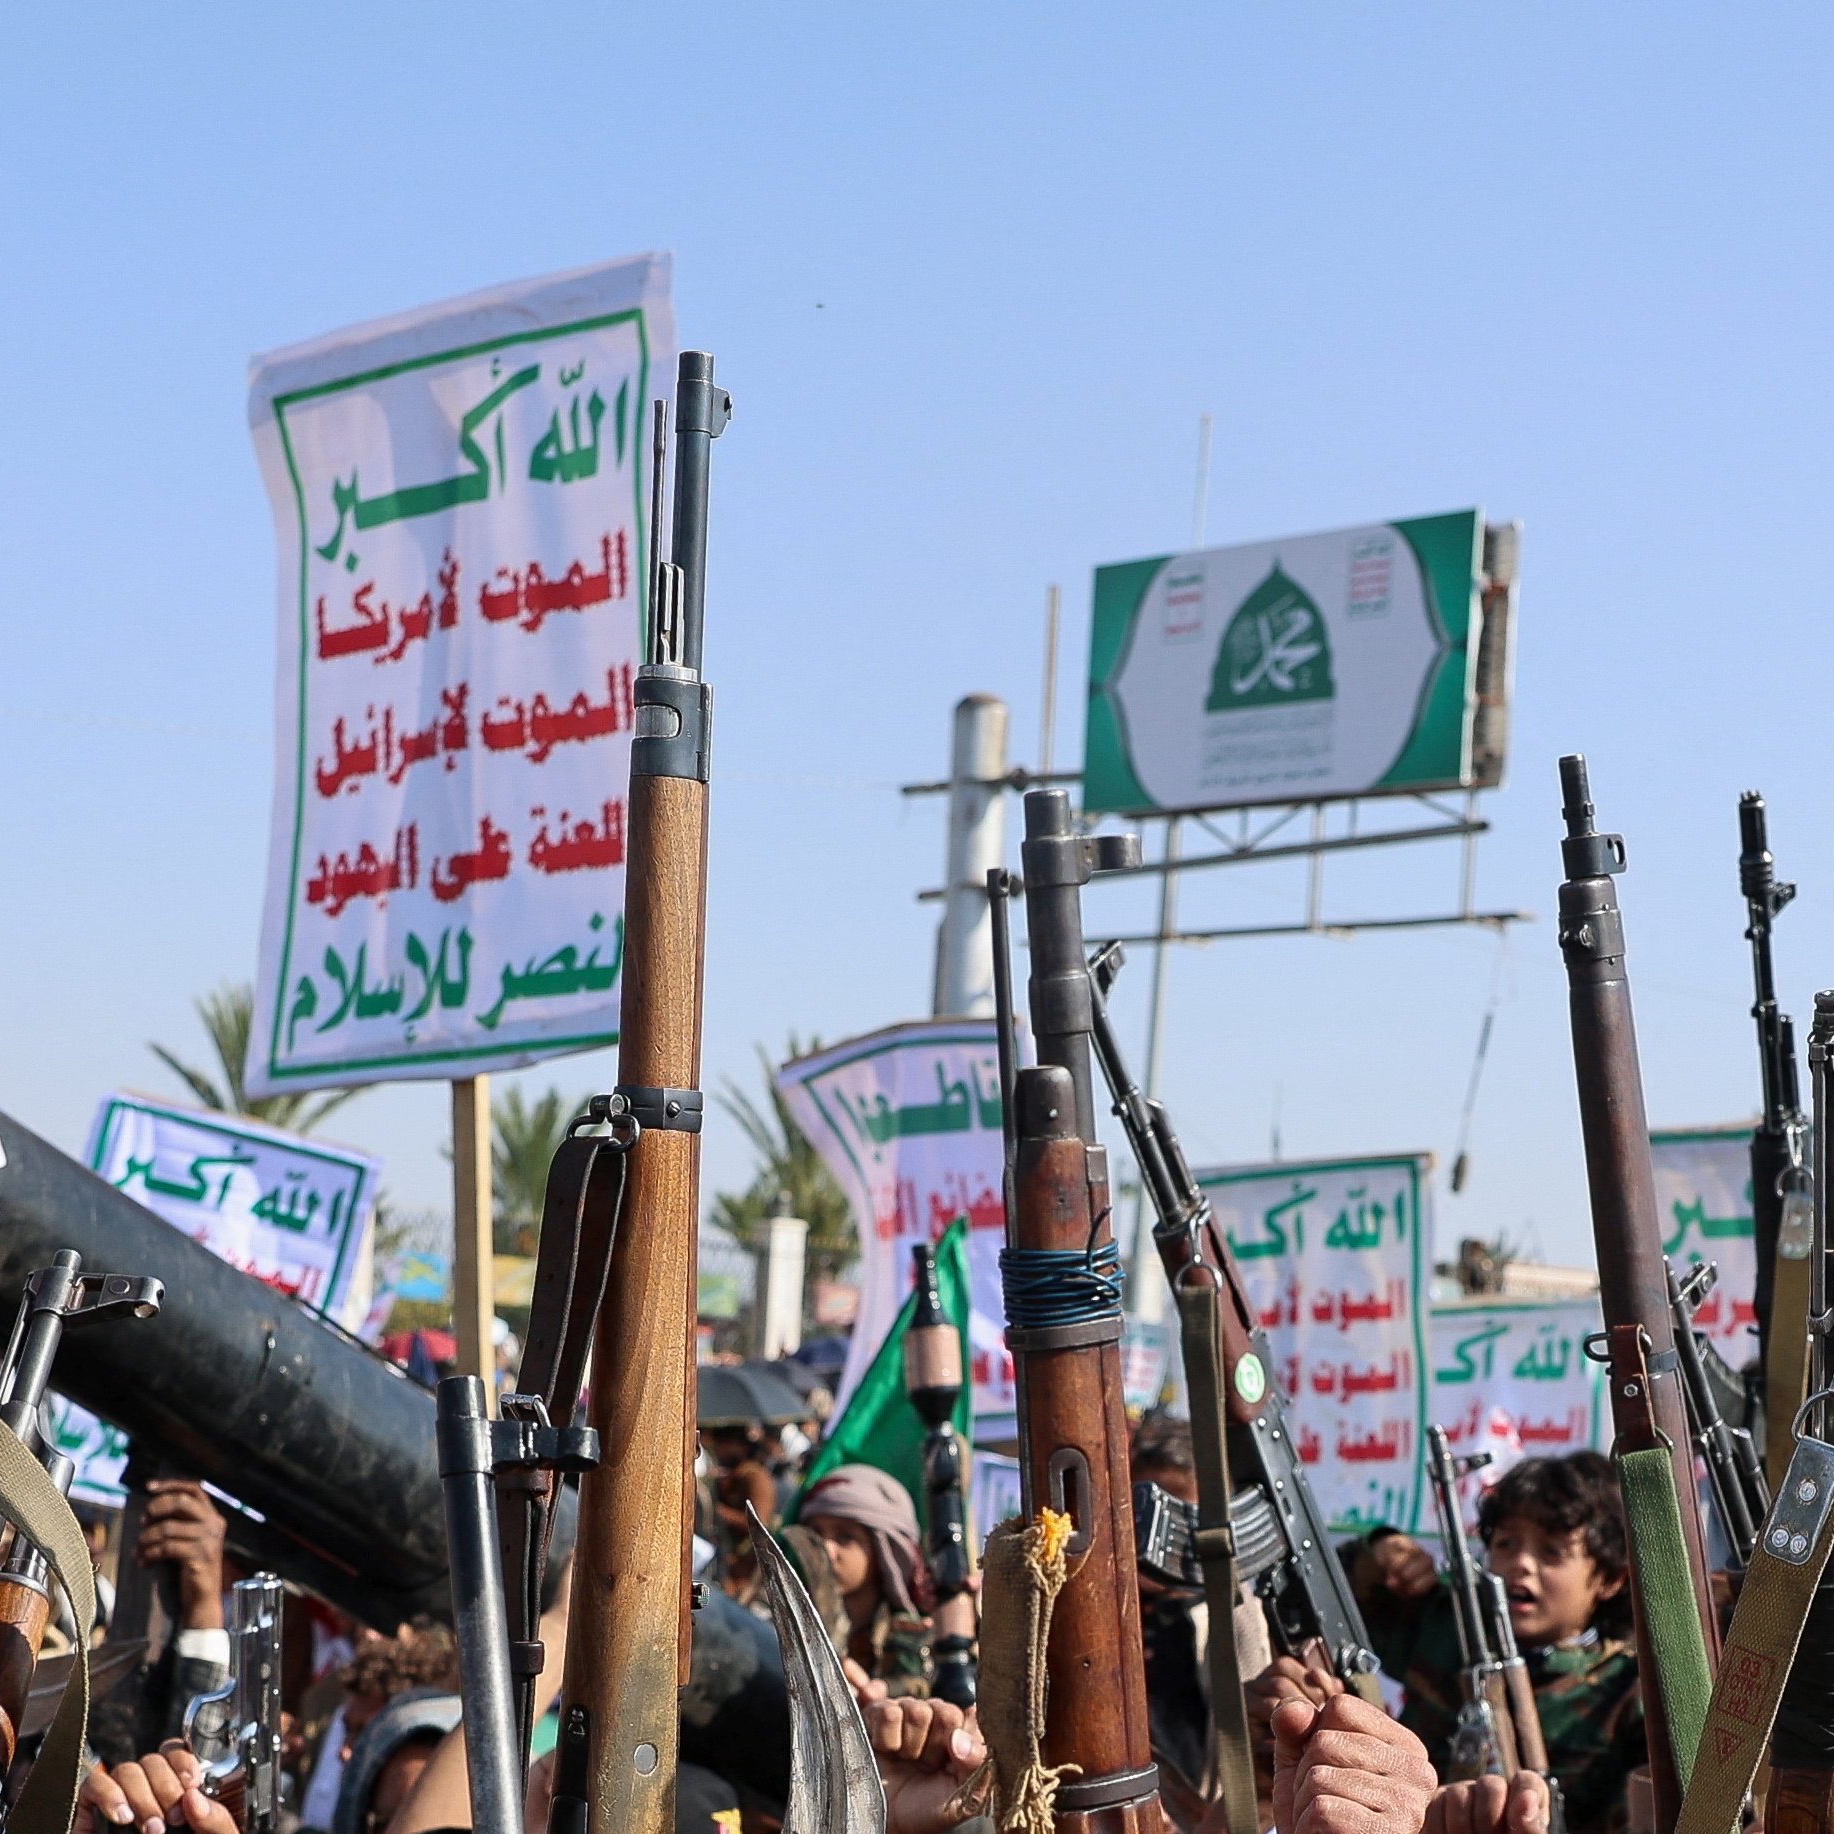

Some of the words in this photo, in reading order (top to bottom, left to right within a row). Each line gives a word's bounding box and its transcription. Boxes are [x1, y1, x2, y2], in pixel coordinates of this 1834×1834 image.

[315, 355, 540, 574] أكبر
[528, 360, 629, 486] الله
[317, 547, 463, 666] لأمريكا
[479, 528, 629, 634] الموت
[314, 682, 471, 798] لإسرائيل
[479, 663, 633, 763] الموت
[306, 823, 420, 917] اليهود
[431, 816, 513, 902] على
[528, 799, 626, 876] للعنة
[287, 926, 473, 1055] للإسلام
[477, 911, 623, 1033] لنصر
[251, 1165, 345, 1236] الله
[1226, 1182, 1316, 1260] أك
[1325, 1182, 1404, 1251] الله
[1312, 1280, 1405, 1333] الموت
[1435, 1322, 1509, 1385] أك
[1311, 1353, 1411, 1403] الموت
